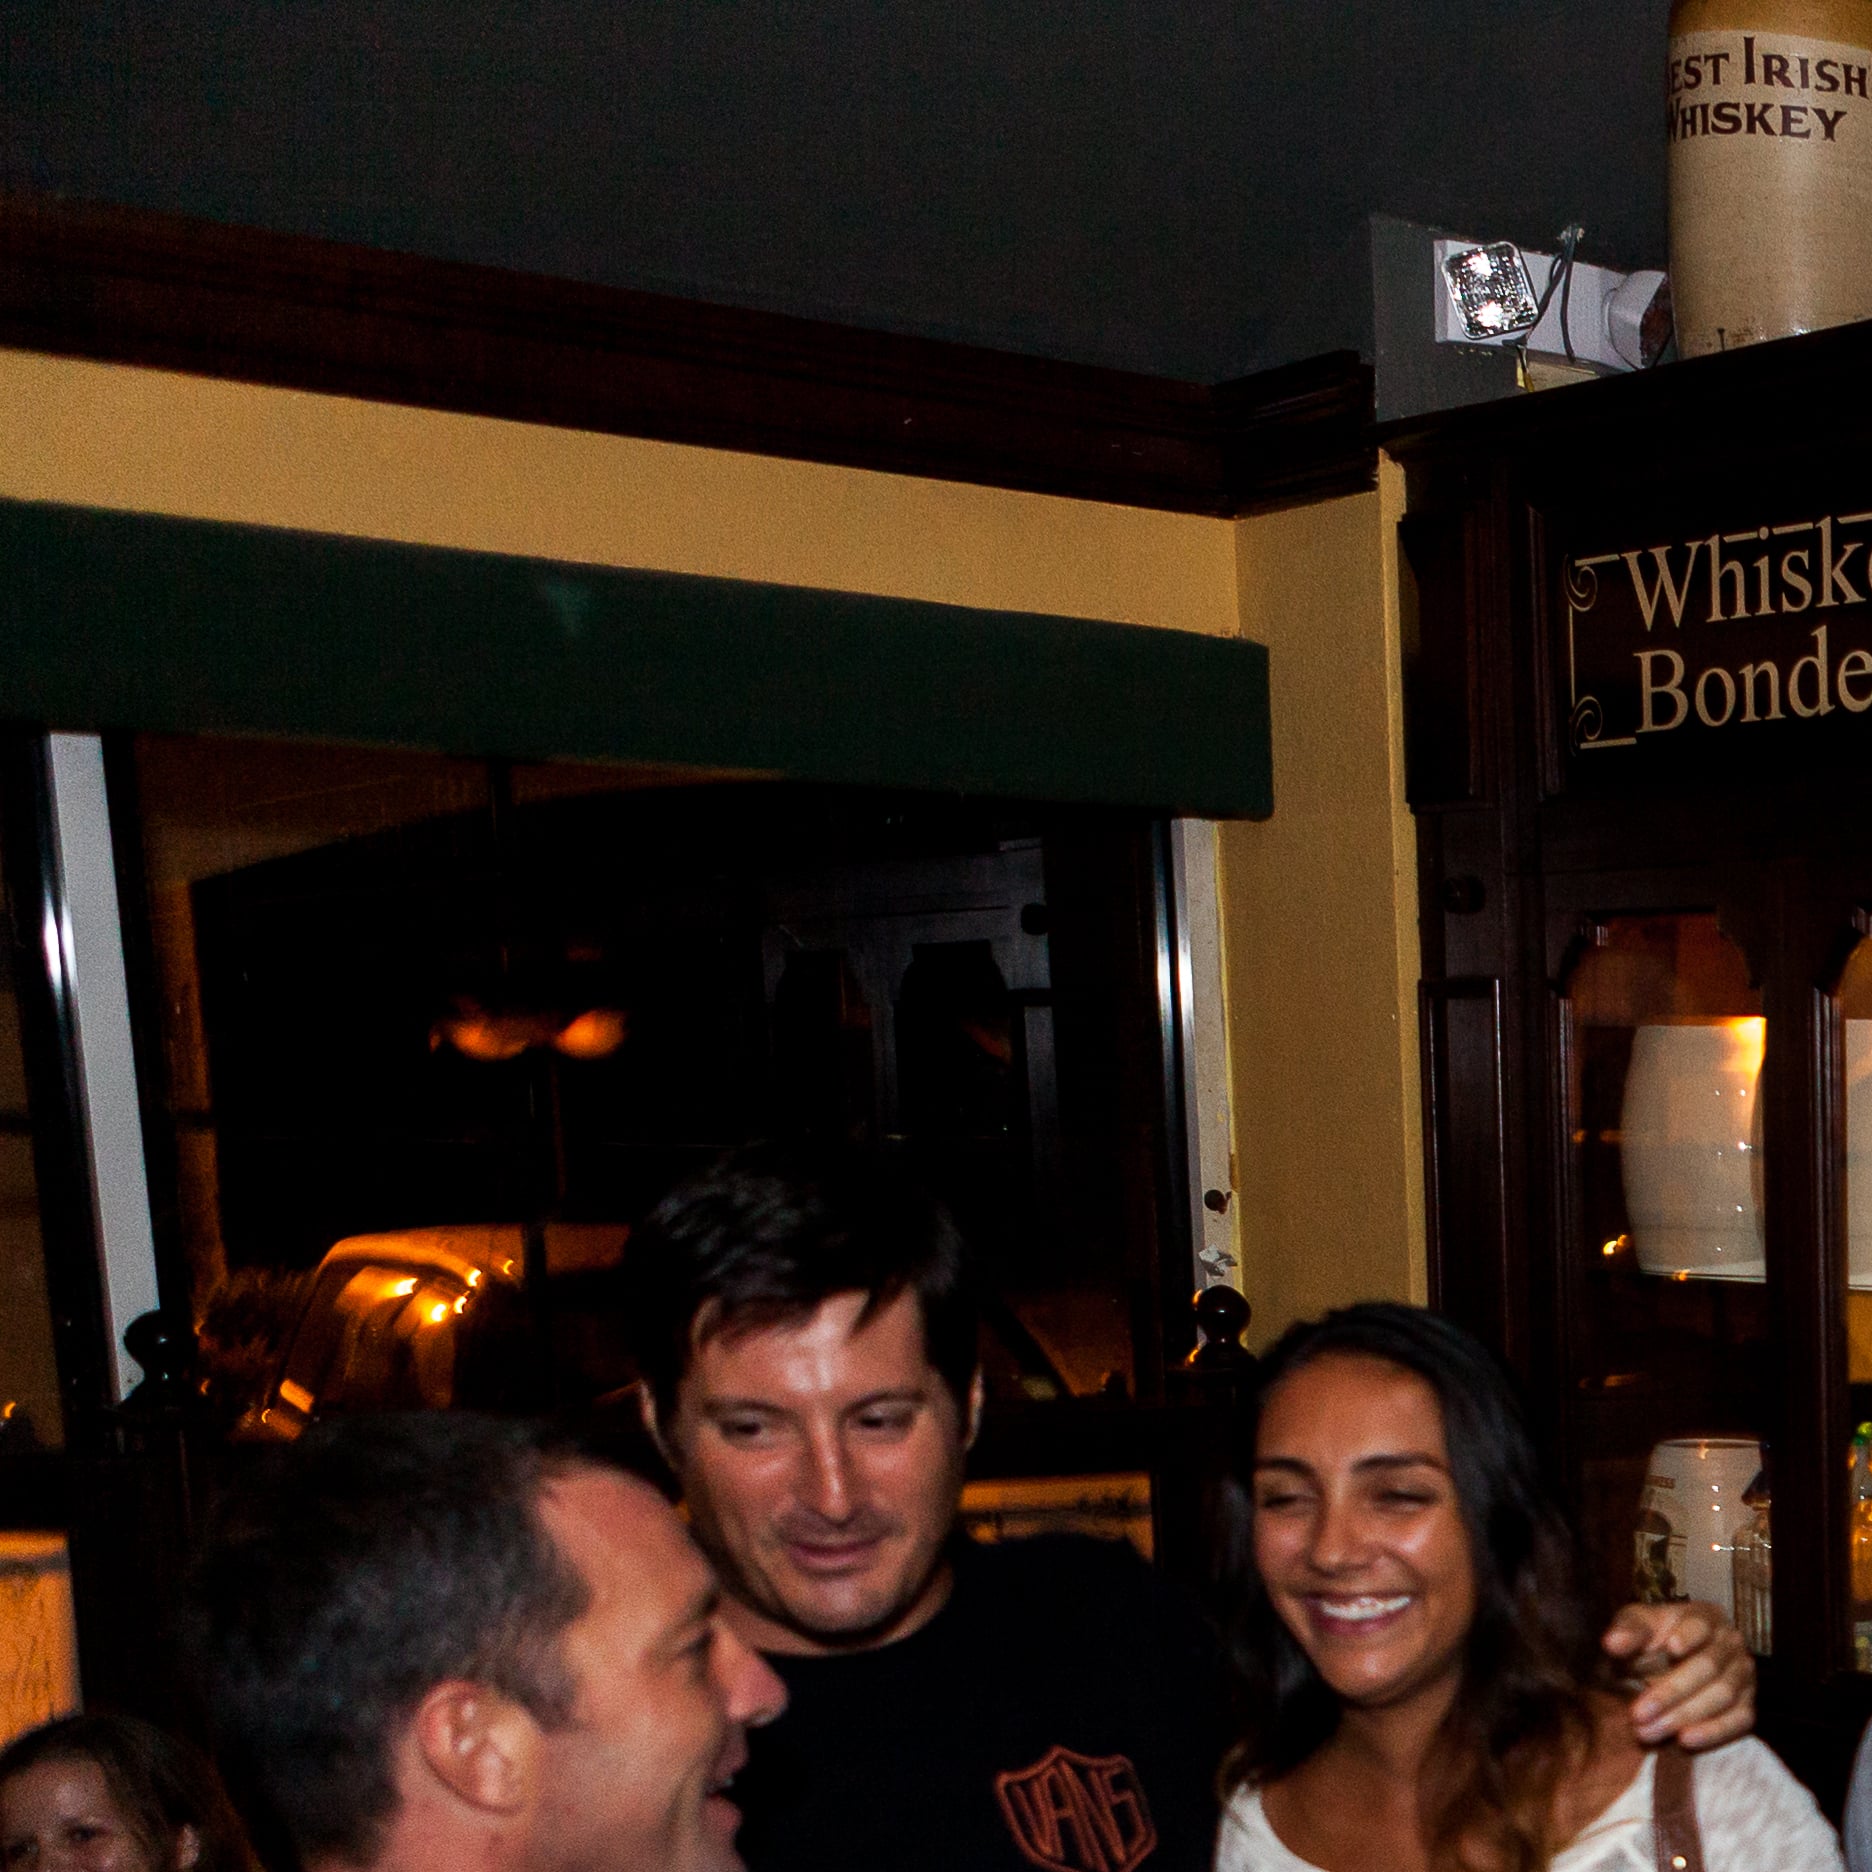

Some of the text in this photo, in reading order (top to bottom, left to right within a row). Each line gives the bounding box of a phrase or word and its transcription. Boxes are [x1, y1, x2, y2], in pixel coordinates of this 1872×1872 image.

[1668, 36, 1870, 100] EST IRISH
[1668, 97, 1848, 142] WHISKEY
